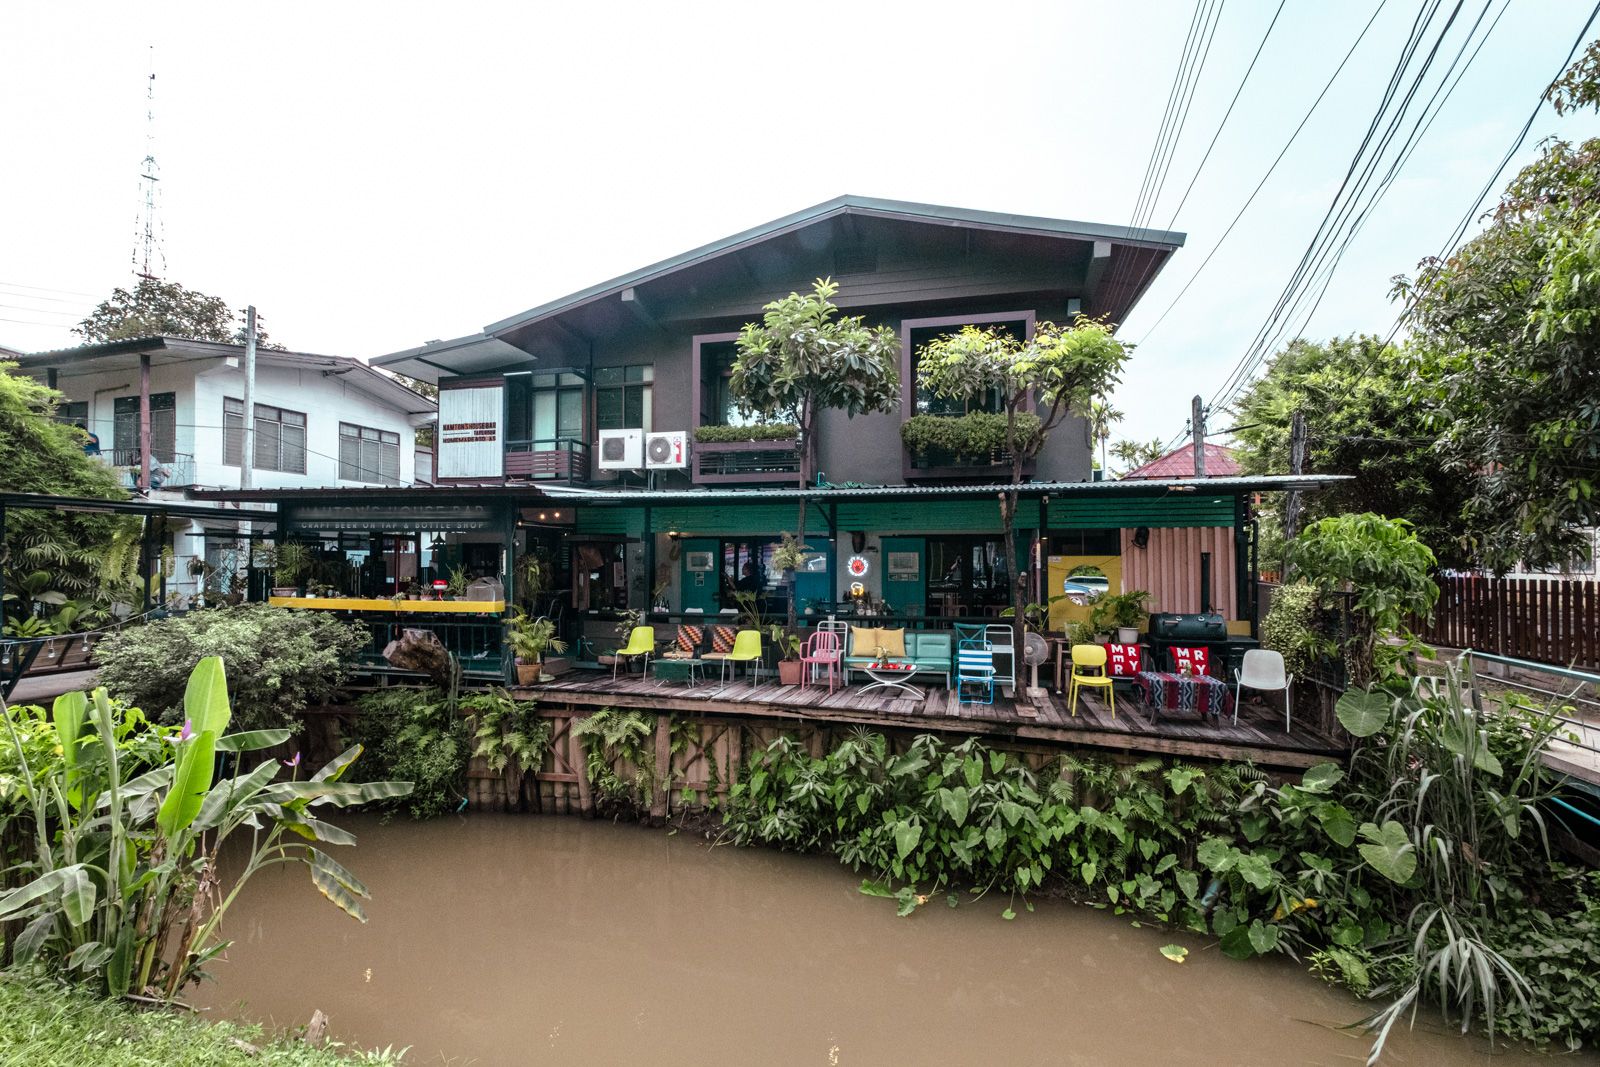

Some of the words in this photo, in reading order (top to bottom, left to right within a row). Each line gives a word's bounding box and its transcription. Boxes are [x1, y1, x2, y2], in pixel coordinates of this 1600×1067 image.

[301, 521, 330, 529] CRAFT
[335, 521, 358, 529] BEER
[362, 521, 376, 529] ON
[381, 521, 398, 529] TAP
[415, 521, 451, 529] BOTTLE
[456, 521, 485, 529] SHOP
